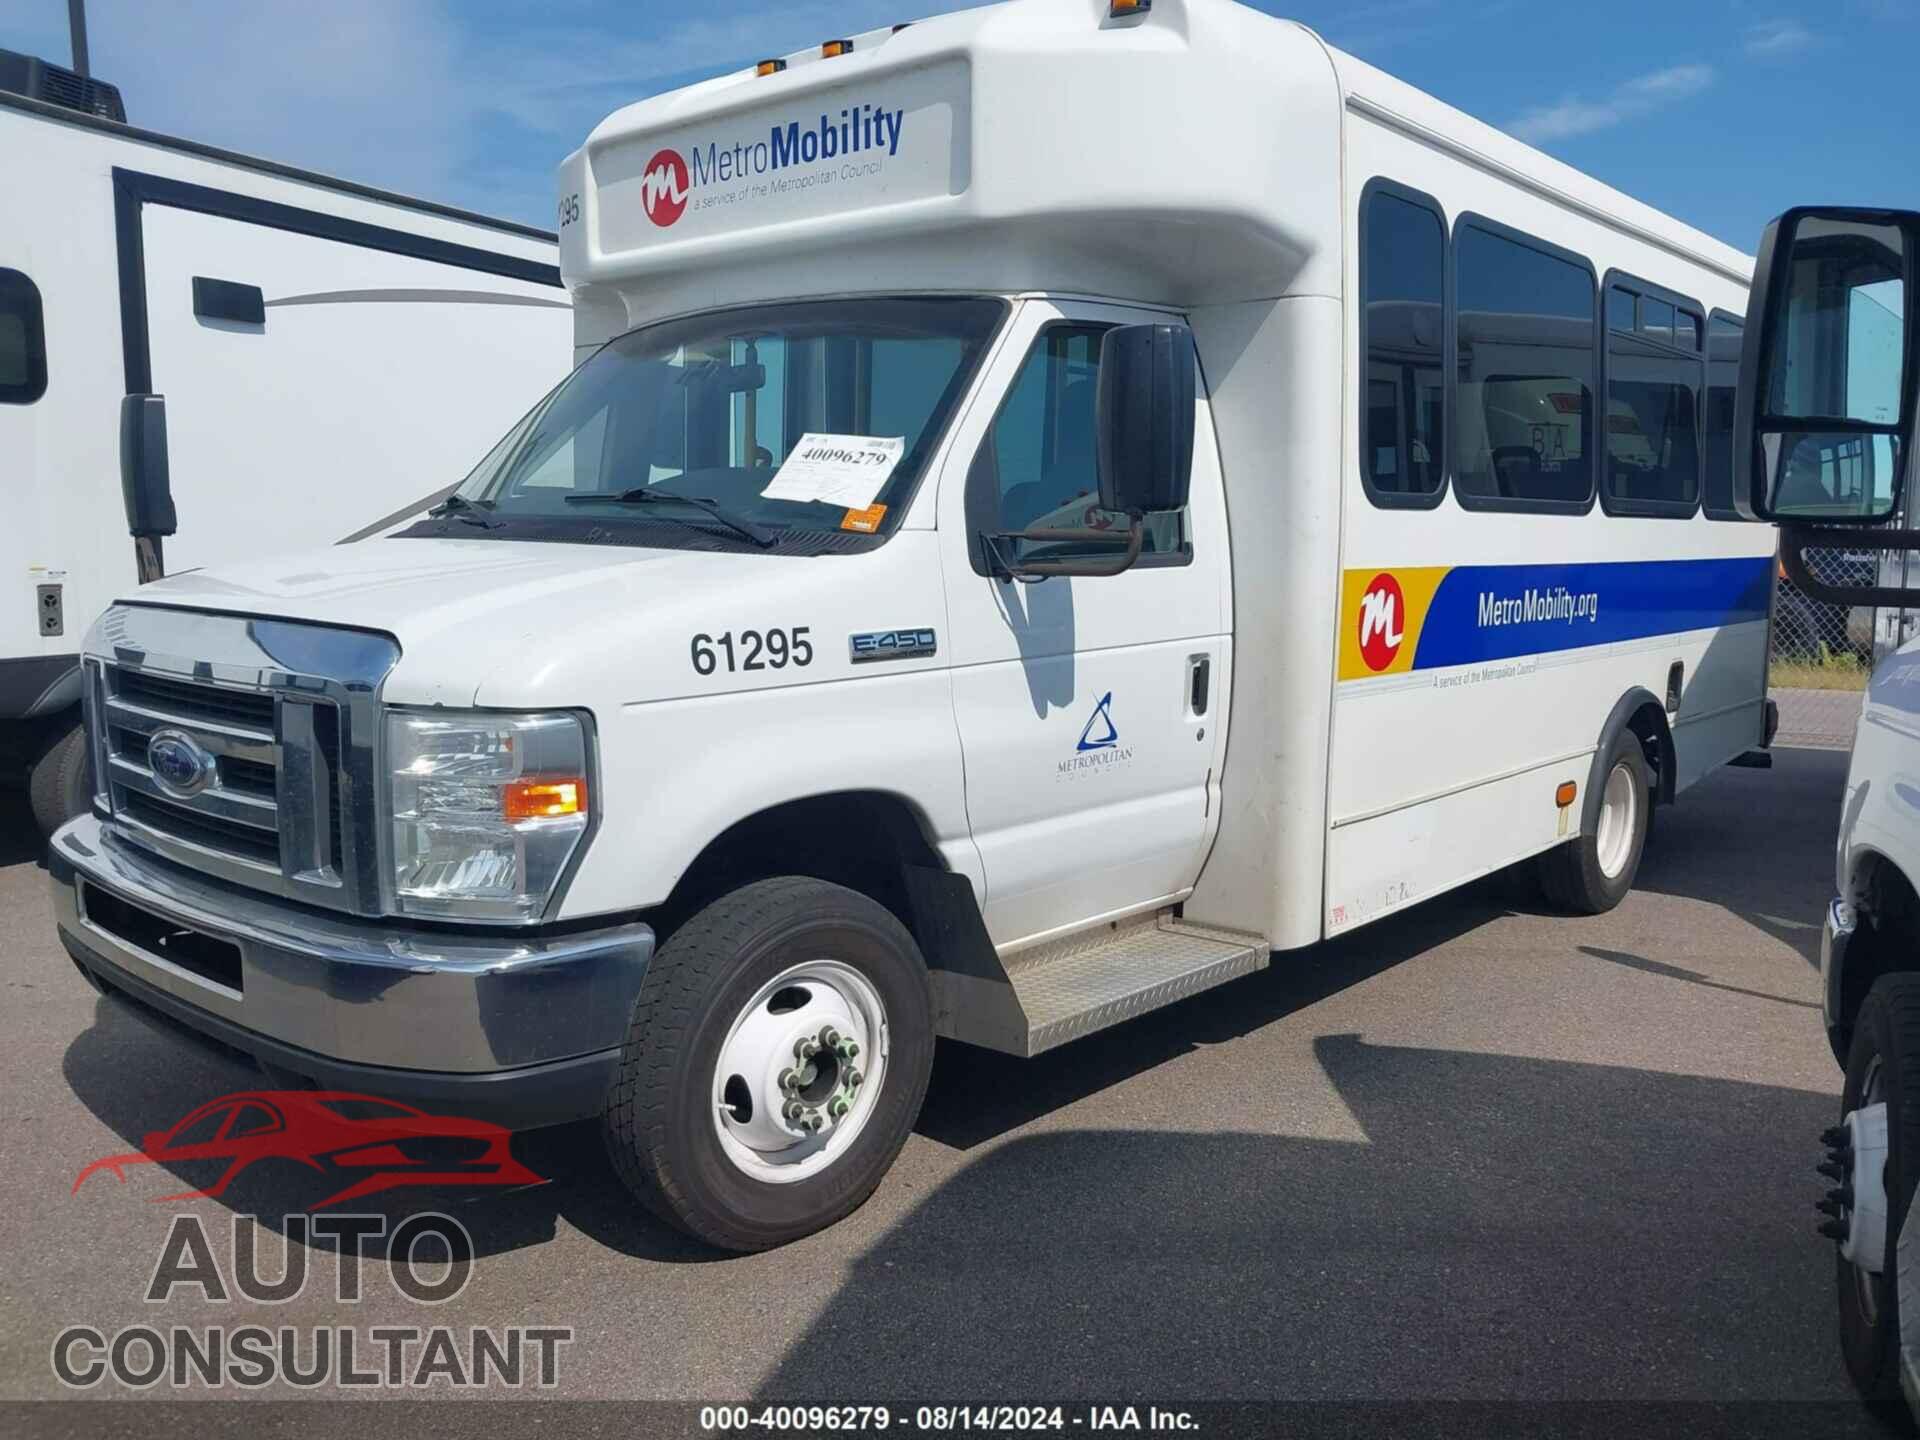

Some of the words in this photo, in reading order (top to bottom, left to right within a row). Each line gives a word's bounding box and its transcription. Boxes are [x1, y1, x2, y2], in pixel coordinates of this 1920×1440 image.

[692, 104, 903, 188] MetroMobility
[702, 191, 736, 208] service
[738, 185, 748, 199] of
[751, 183, 766, 198] the
[769, 167, 836, 194] Metropolitan
[840, 159, 882, 181] Council
[801, 447, 887, 466] 40096279
[1477, 586, 1598, 628] MetroMobility.org
[691, 626, 813, 676] 61295
[1057, 749, 1133, 773] METROPOLITAN
